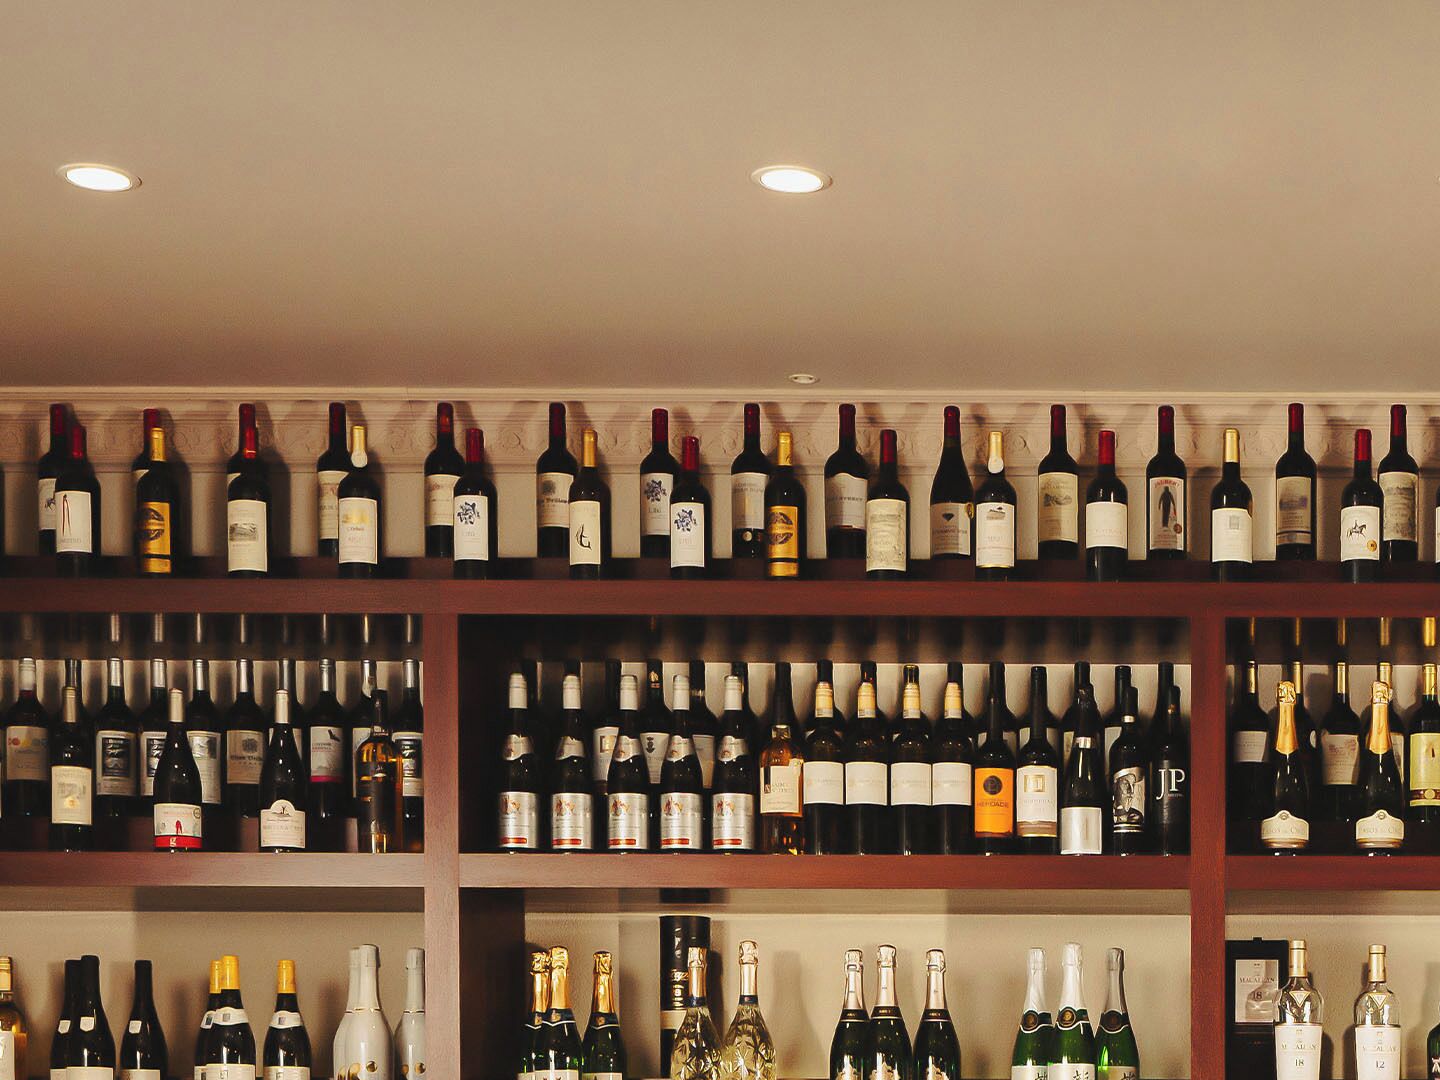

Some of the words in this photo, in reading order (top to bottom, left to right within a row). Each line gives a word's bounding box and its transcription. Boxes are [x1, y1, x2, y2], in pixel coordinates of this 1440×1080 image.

[1156, 768, 1185, 800] JP
[1252, 991, 1263, 1000] 18
[1295, 1059, 1305, 1067] 18
[1375, 1061, 1385, 1069] 12
